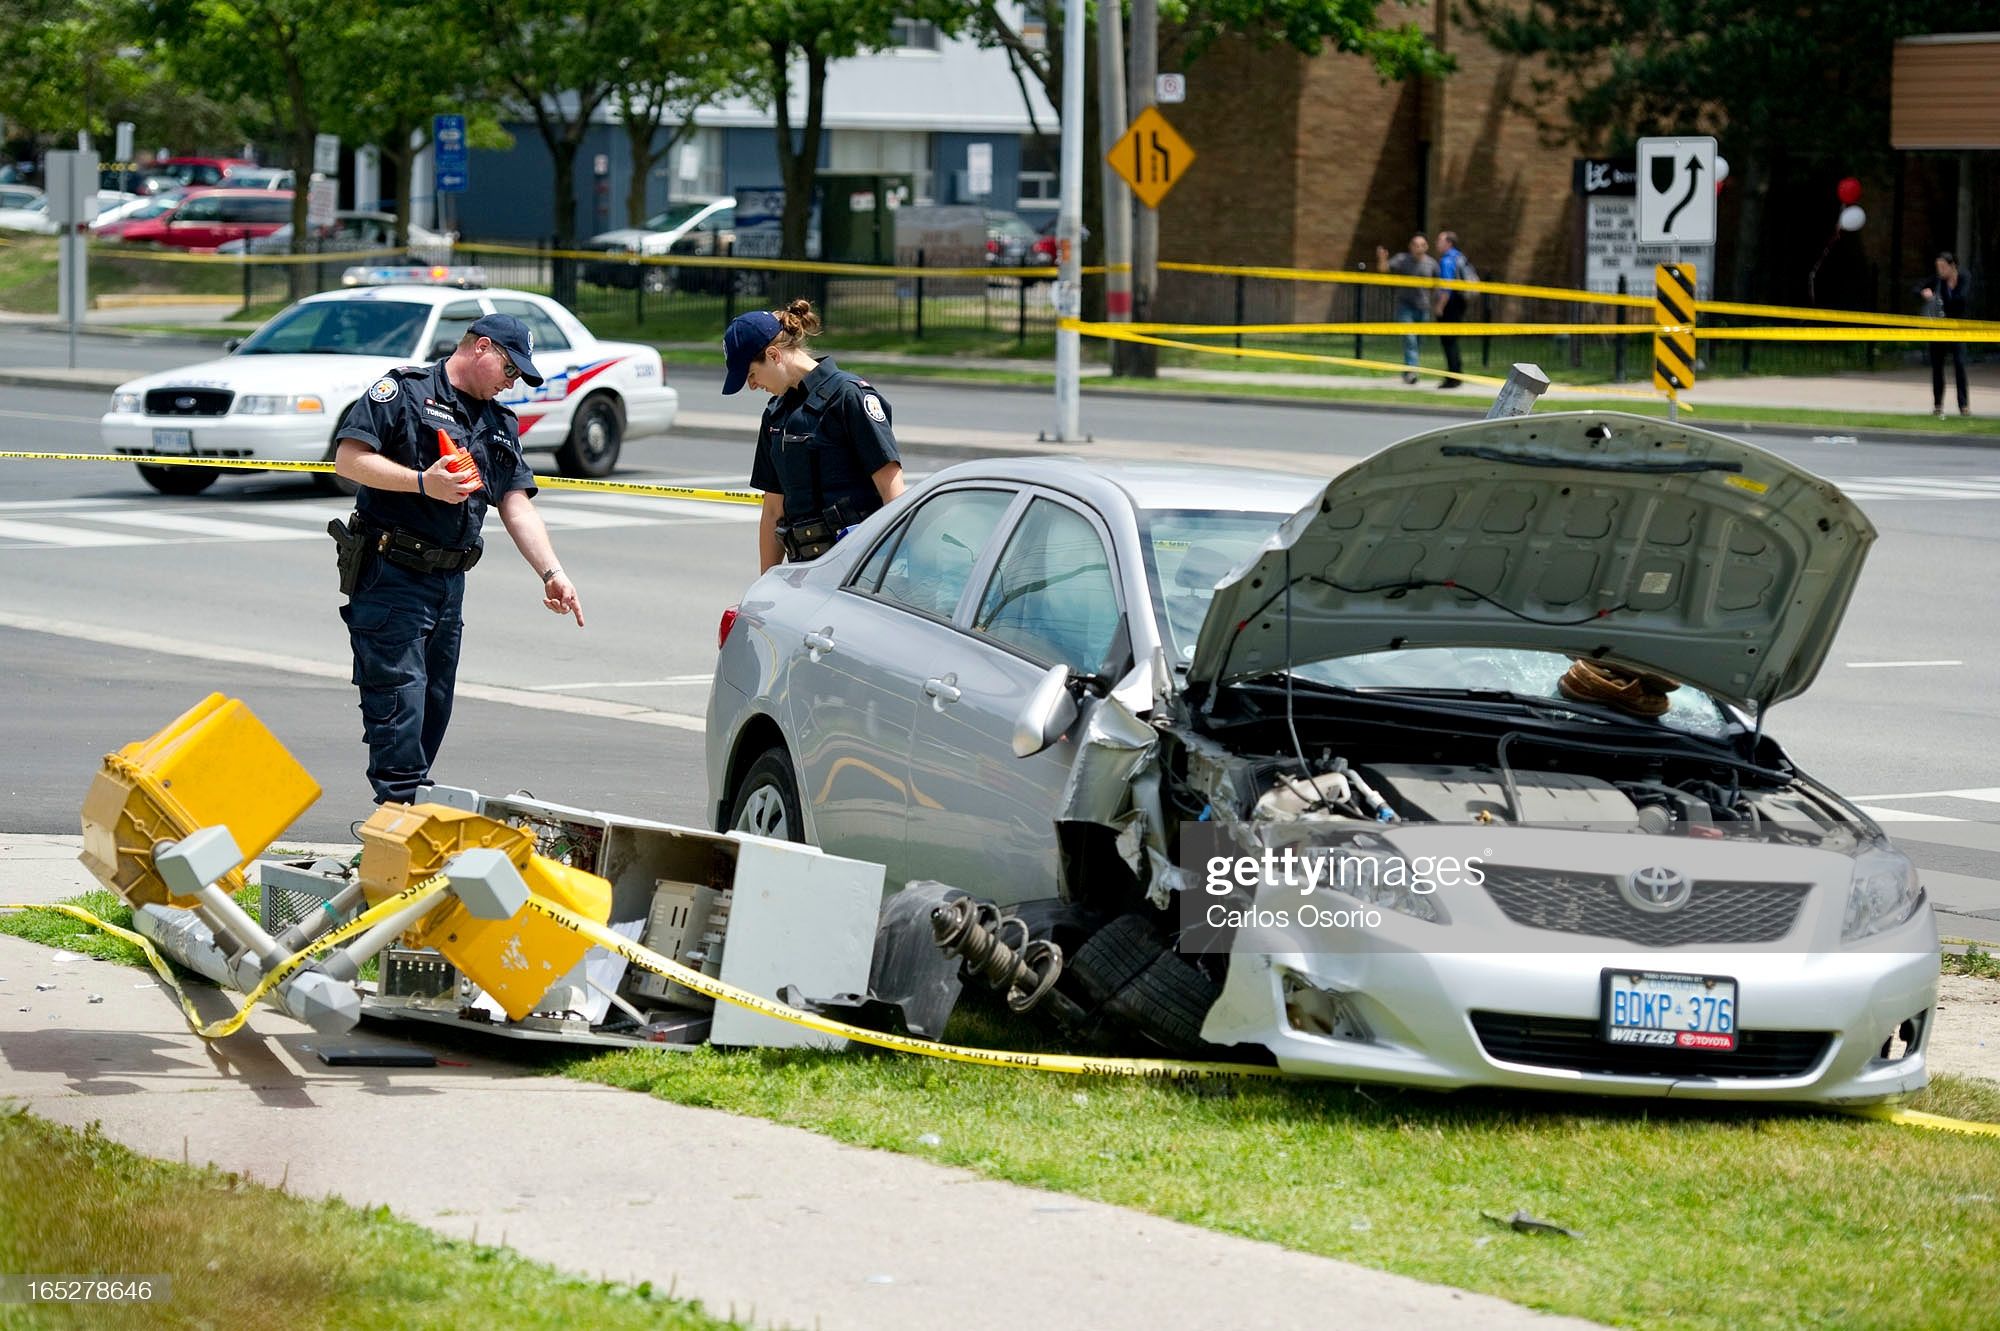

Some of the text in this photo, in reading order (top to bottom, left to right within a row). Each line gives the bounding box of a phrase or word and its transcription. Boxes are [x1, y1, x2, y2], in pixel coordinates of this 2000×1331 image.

[1615, 990, 1732, 1033] BDKP 376
[1610, 1028, 1731, 1047] WIETZES TOYOTA
[1082, 1061, 1136, 1078] CROSS
